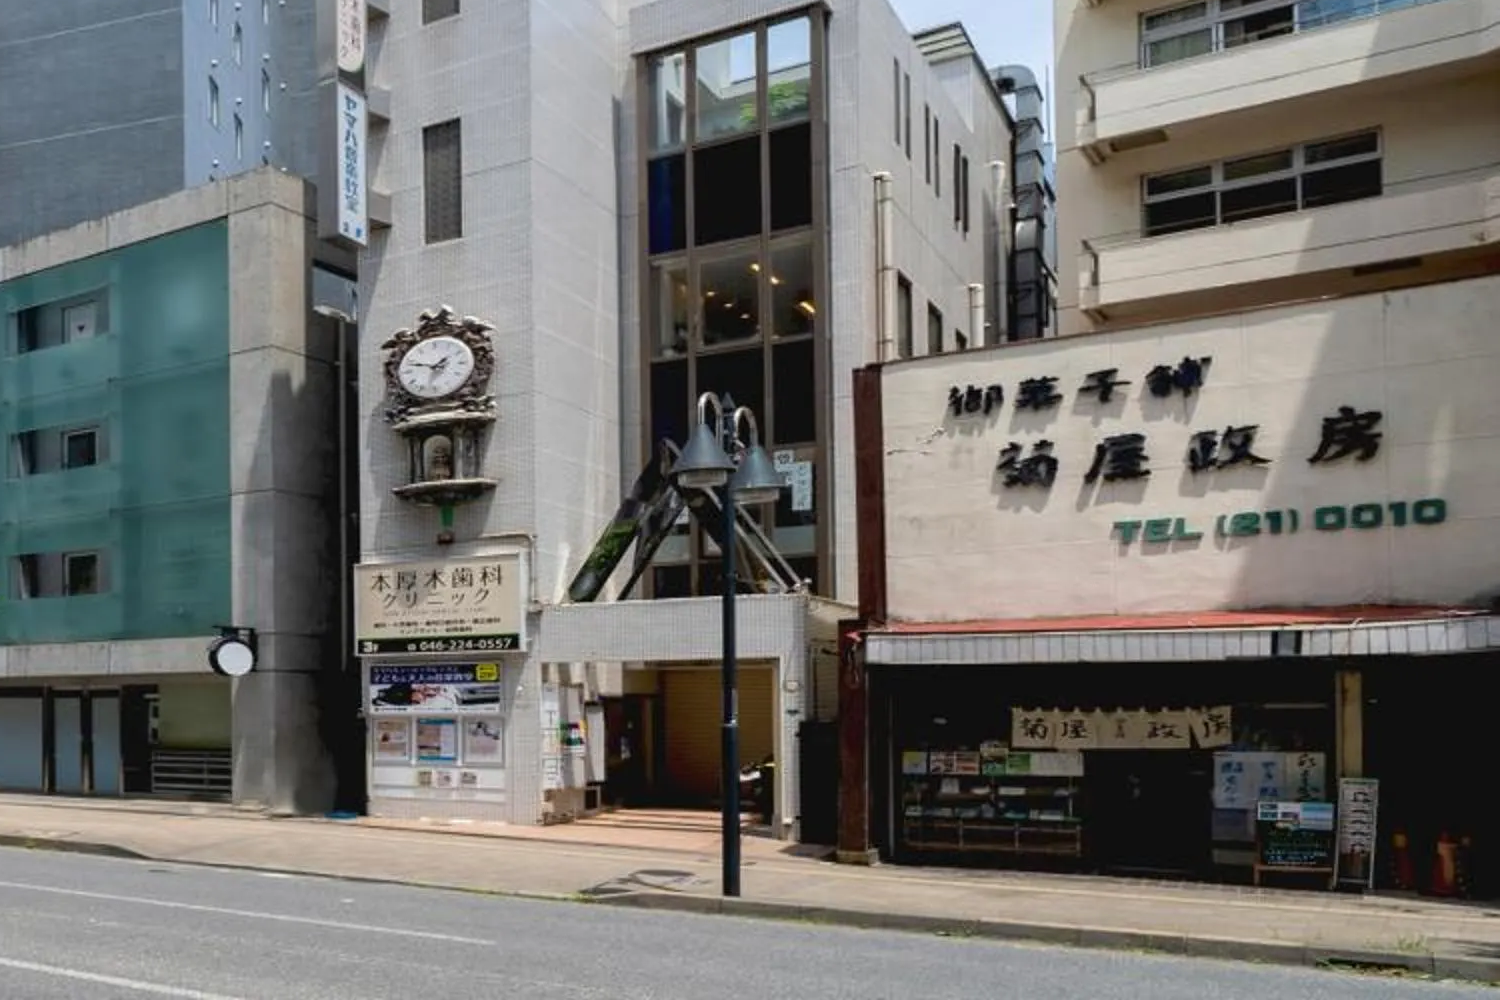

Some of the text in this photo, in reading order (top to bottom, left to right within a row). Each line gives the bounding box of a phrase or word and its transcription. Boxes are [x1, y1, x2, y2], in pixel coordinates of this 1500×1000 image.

[1111, 497, 1448, 545] TEL (21) 0010
[384, 587, 490, 609] クリニック
[419, 638, 512, 652] 046-224-0557
